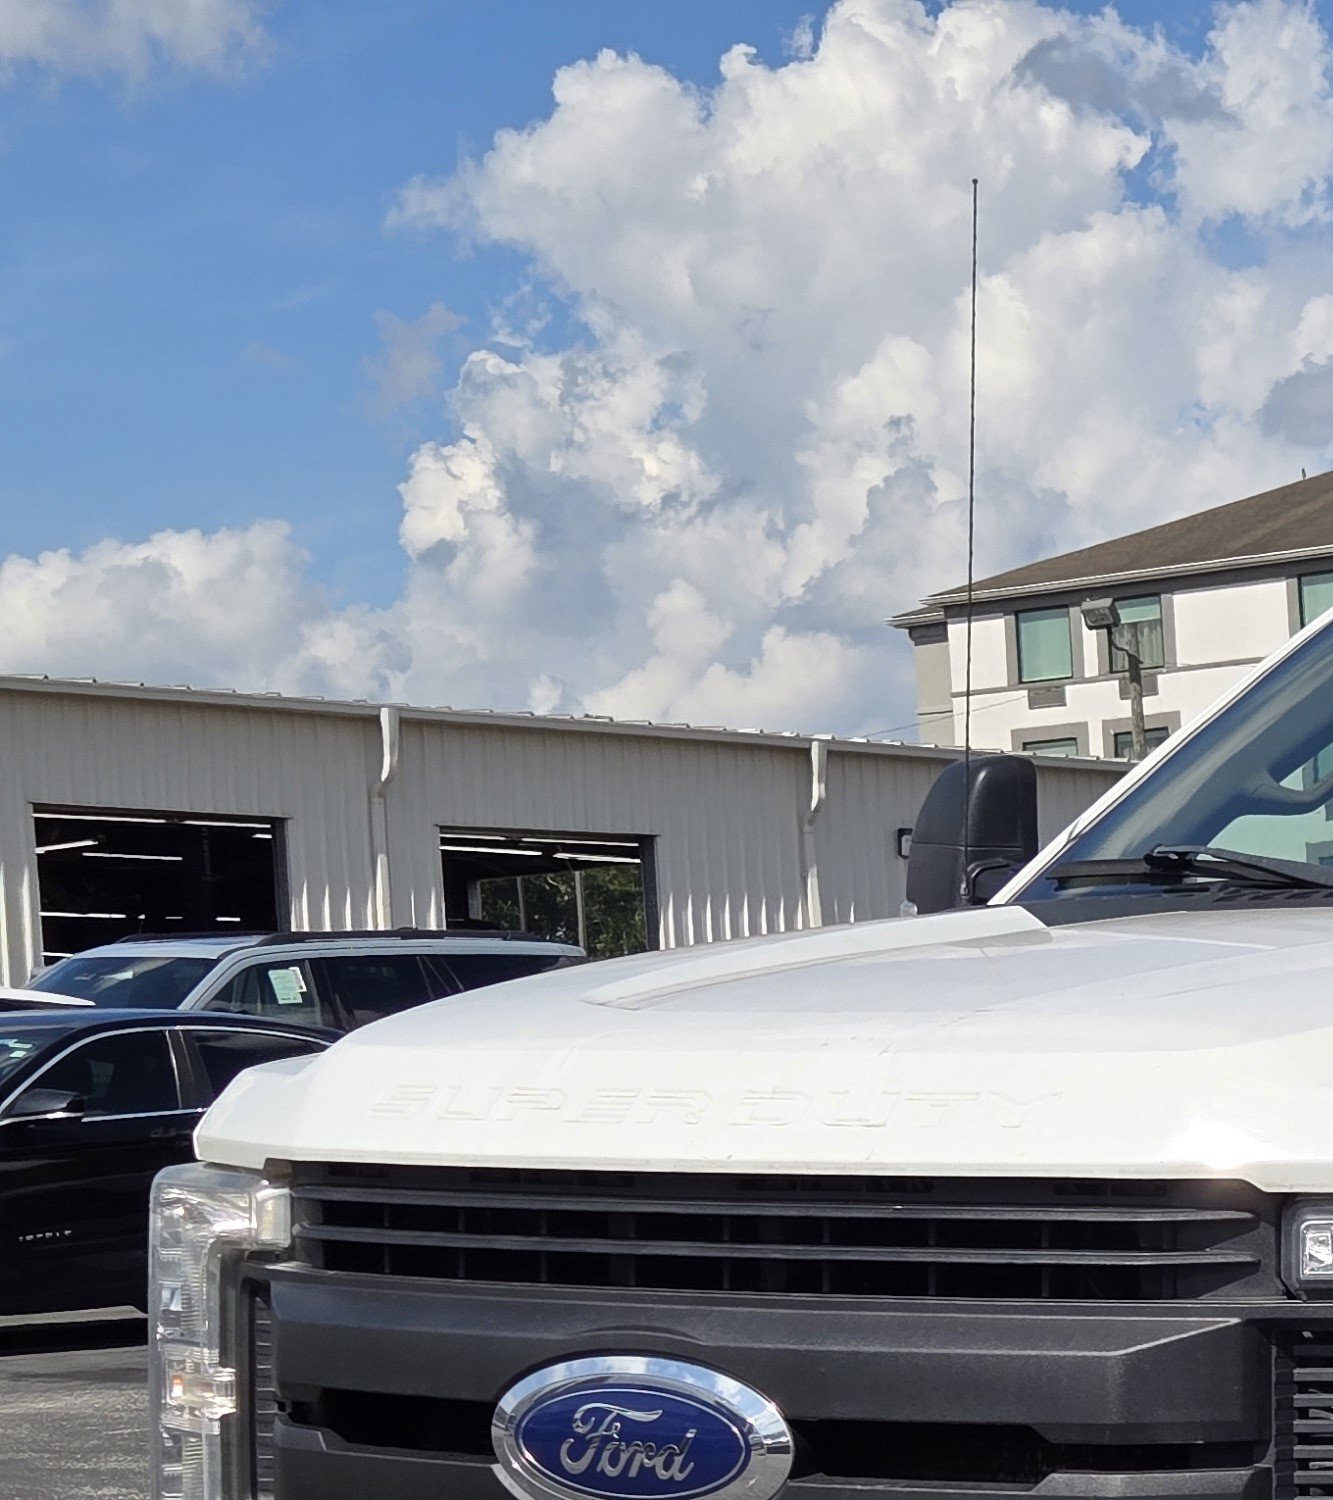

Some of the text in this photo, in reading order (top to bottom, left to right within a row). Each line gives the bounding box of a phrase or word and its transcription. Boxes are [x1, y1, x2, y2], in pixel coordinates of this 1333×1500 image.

[367, 1084, 1064, 1128] SUPER DUTY
[560, 1402, 697, 1481] Ford
